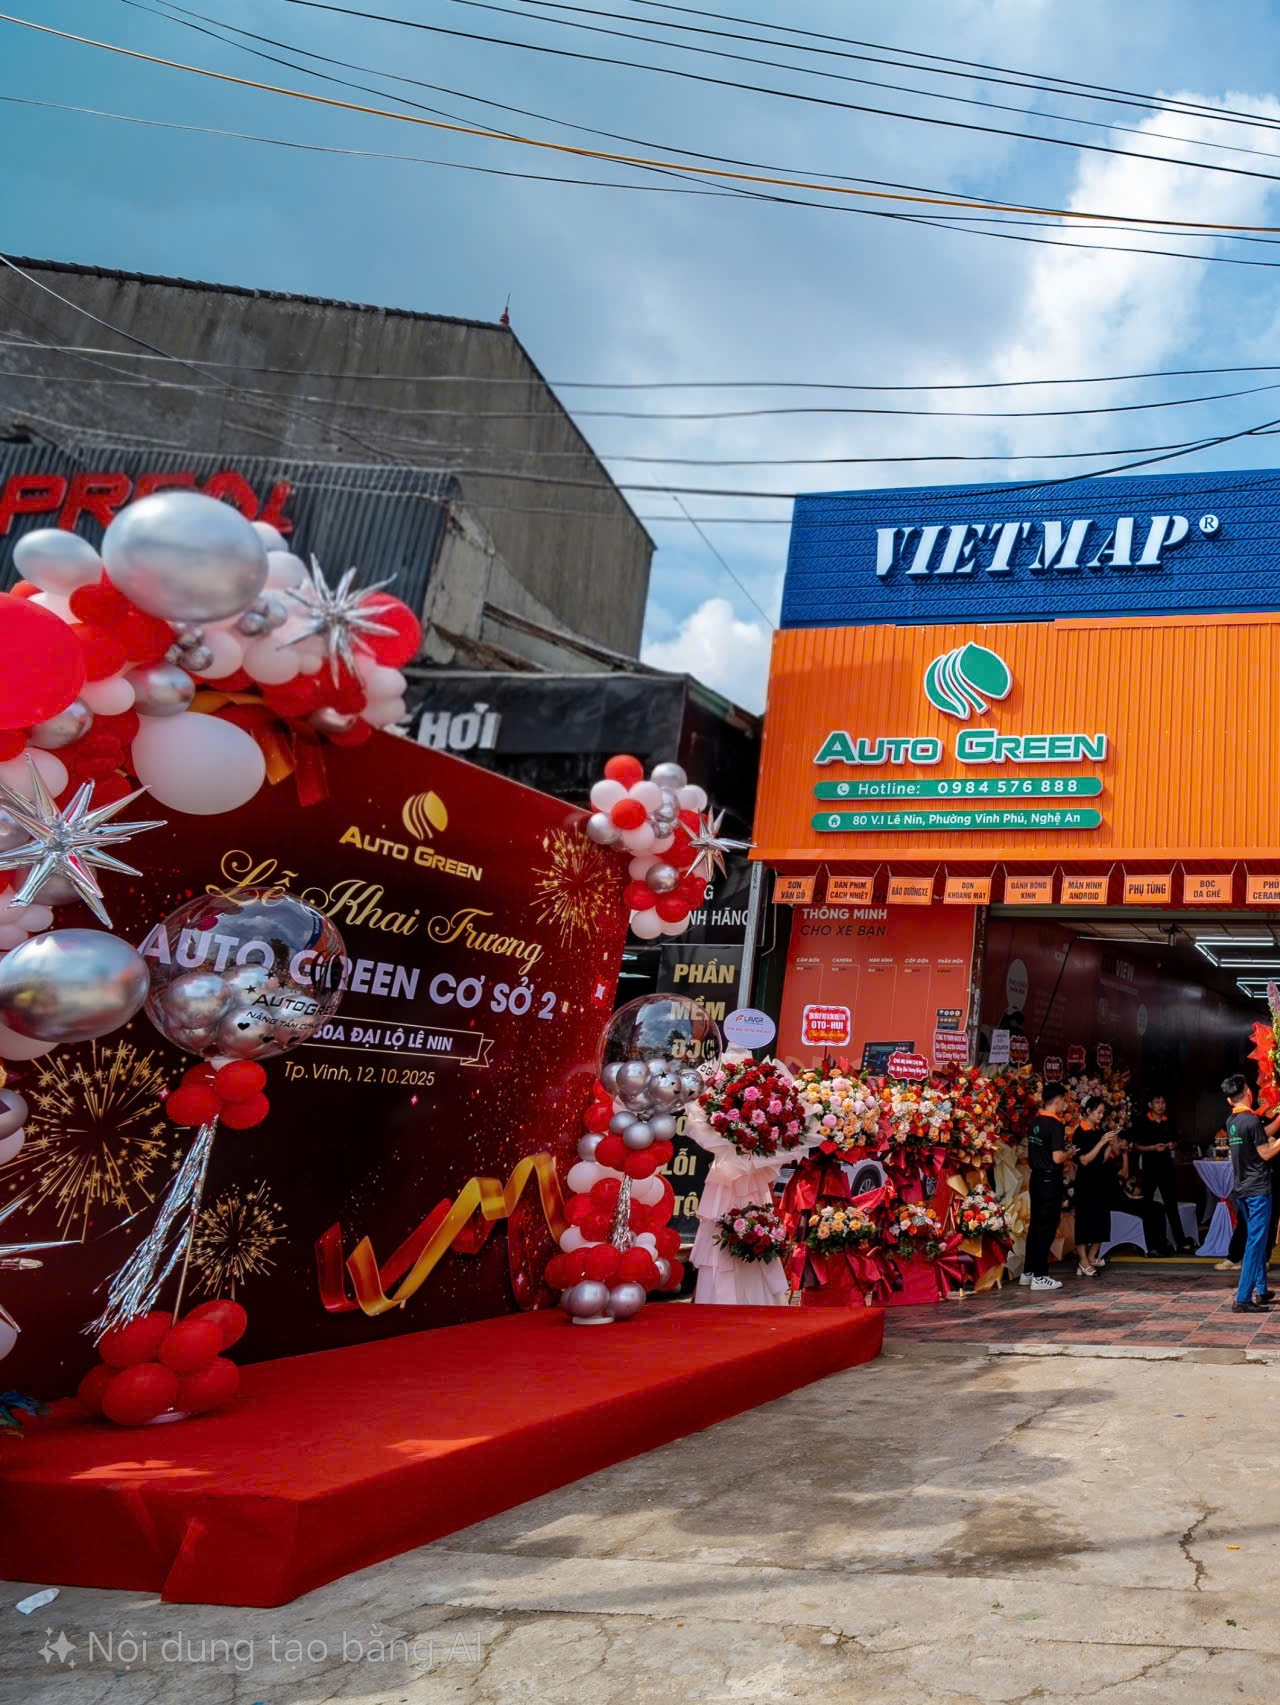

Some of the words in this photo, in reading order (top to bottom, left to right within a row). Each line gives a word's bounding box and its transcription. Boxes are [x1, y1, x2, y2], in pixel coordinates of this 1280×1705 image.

[876, 515, 1190, 576] VIETMAP
[813, 731, 942, 764] AUTO
[955, 728, 1106, 763] GREEN
[858, 783, 921, 795] Hotline:
[937, 780, 989, 794] 0984
[997, 780, 1033, 793] 576
[1040, 780, 1078, 793] 888
[852, 815, 867, 825] 80
[887, 813, 901, 825] Lê
[903, 814, 926, 826] Nin,
[928, 813, 972, 828] Phường
[974, 812, 1000, 824] Vinh
[1003, 812, 1028, 826] Phú,
[1031, 812, 1061, 827] Nghệ
[1064, 813, 1080, 823] An
[339, 825, 408, 861] AUTO
[414, 846, 483, 882] GREEN
[849, 881, 867, 889] PHIM
[1128, 884, 1143, 896] PHỤ
[1146, 881, 1167, 894] TÙNG
[1193, 890, 1205, 898] DA
[1069, 892, 1099, 900] ANDROID
[205, 849, 299, 908] Lễ
[300, 878, 421, 937] Khai
[427, 907, 544, 977] Trương
[802, 906, 849, 920] THÔNG
[853, 908, 888, 920] MINH
[800, 925, 832, 936] CHO
[836, 925, 852, 936] XE
[137, 923, 274, 973] AUTO
[429, 973, 488, 1007] CƠ
[490, 974, 535, 1014] SỞ
[539, 991, 557, 1021] 2
[673, 958, 736, 984] PHẦN
[350, 1029, 381, 1050] ĐẠI
[384, 1025, 405, 1052] LỘ
[408, 1027, 425, 1050] LÊ
[428, 1033, 453, 1053] NIN
[284, 1062, 309, 1084] Tp.
[312, 1063, 352, 1084] Vinh,
[356, 1065, 435, 1086] 12.10.2025
